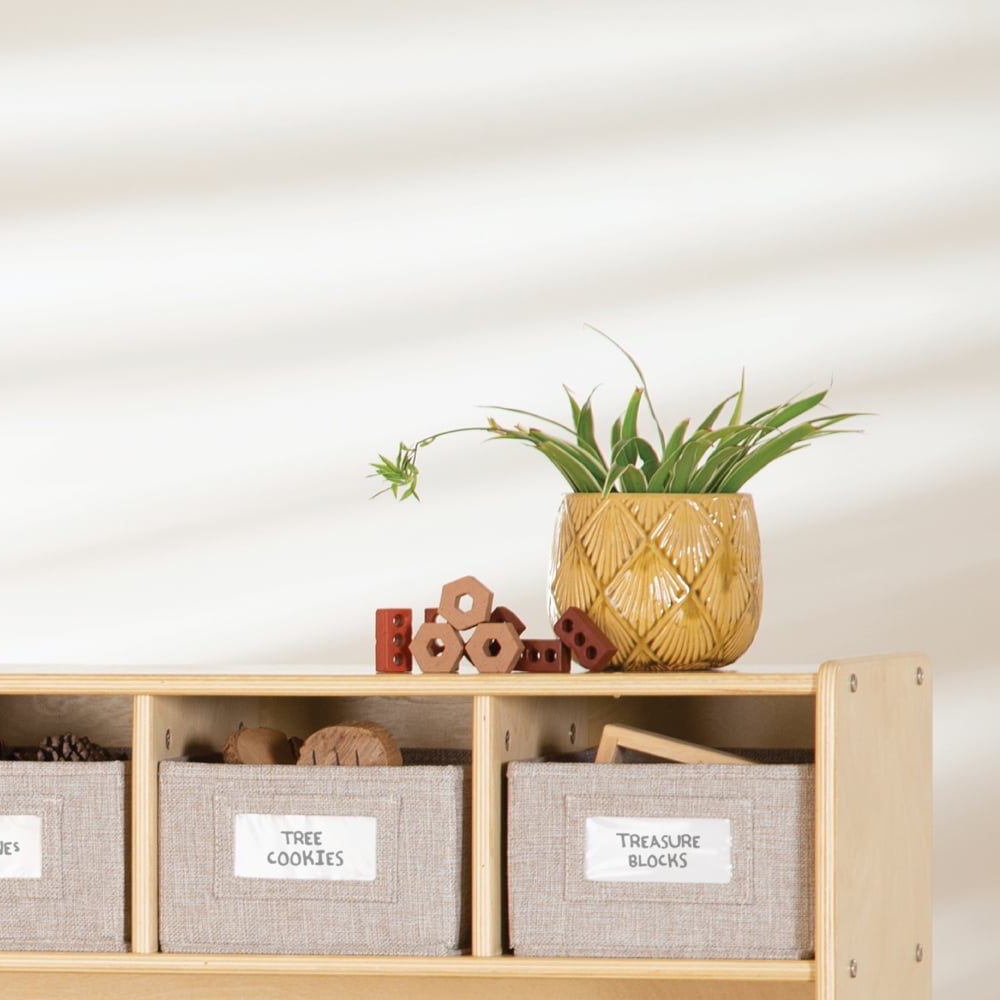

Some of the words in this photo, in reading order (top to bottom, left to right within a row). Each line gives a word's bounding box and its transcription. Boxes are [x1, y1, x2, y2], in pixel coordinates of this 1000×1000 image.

[280, 831, 322, 846] TREE
[616, 832, 701, 849] TREASURE
[267, 850, 344, 867] COOKIES
[628, 853, 687, 868] BLOCKS
